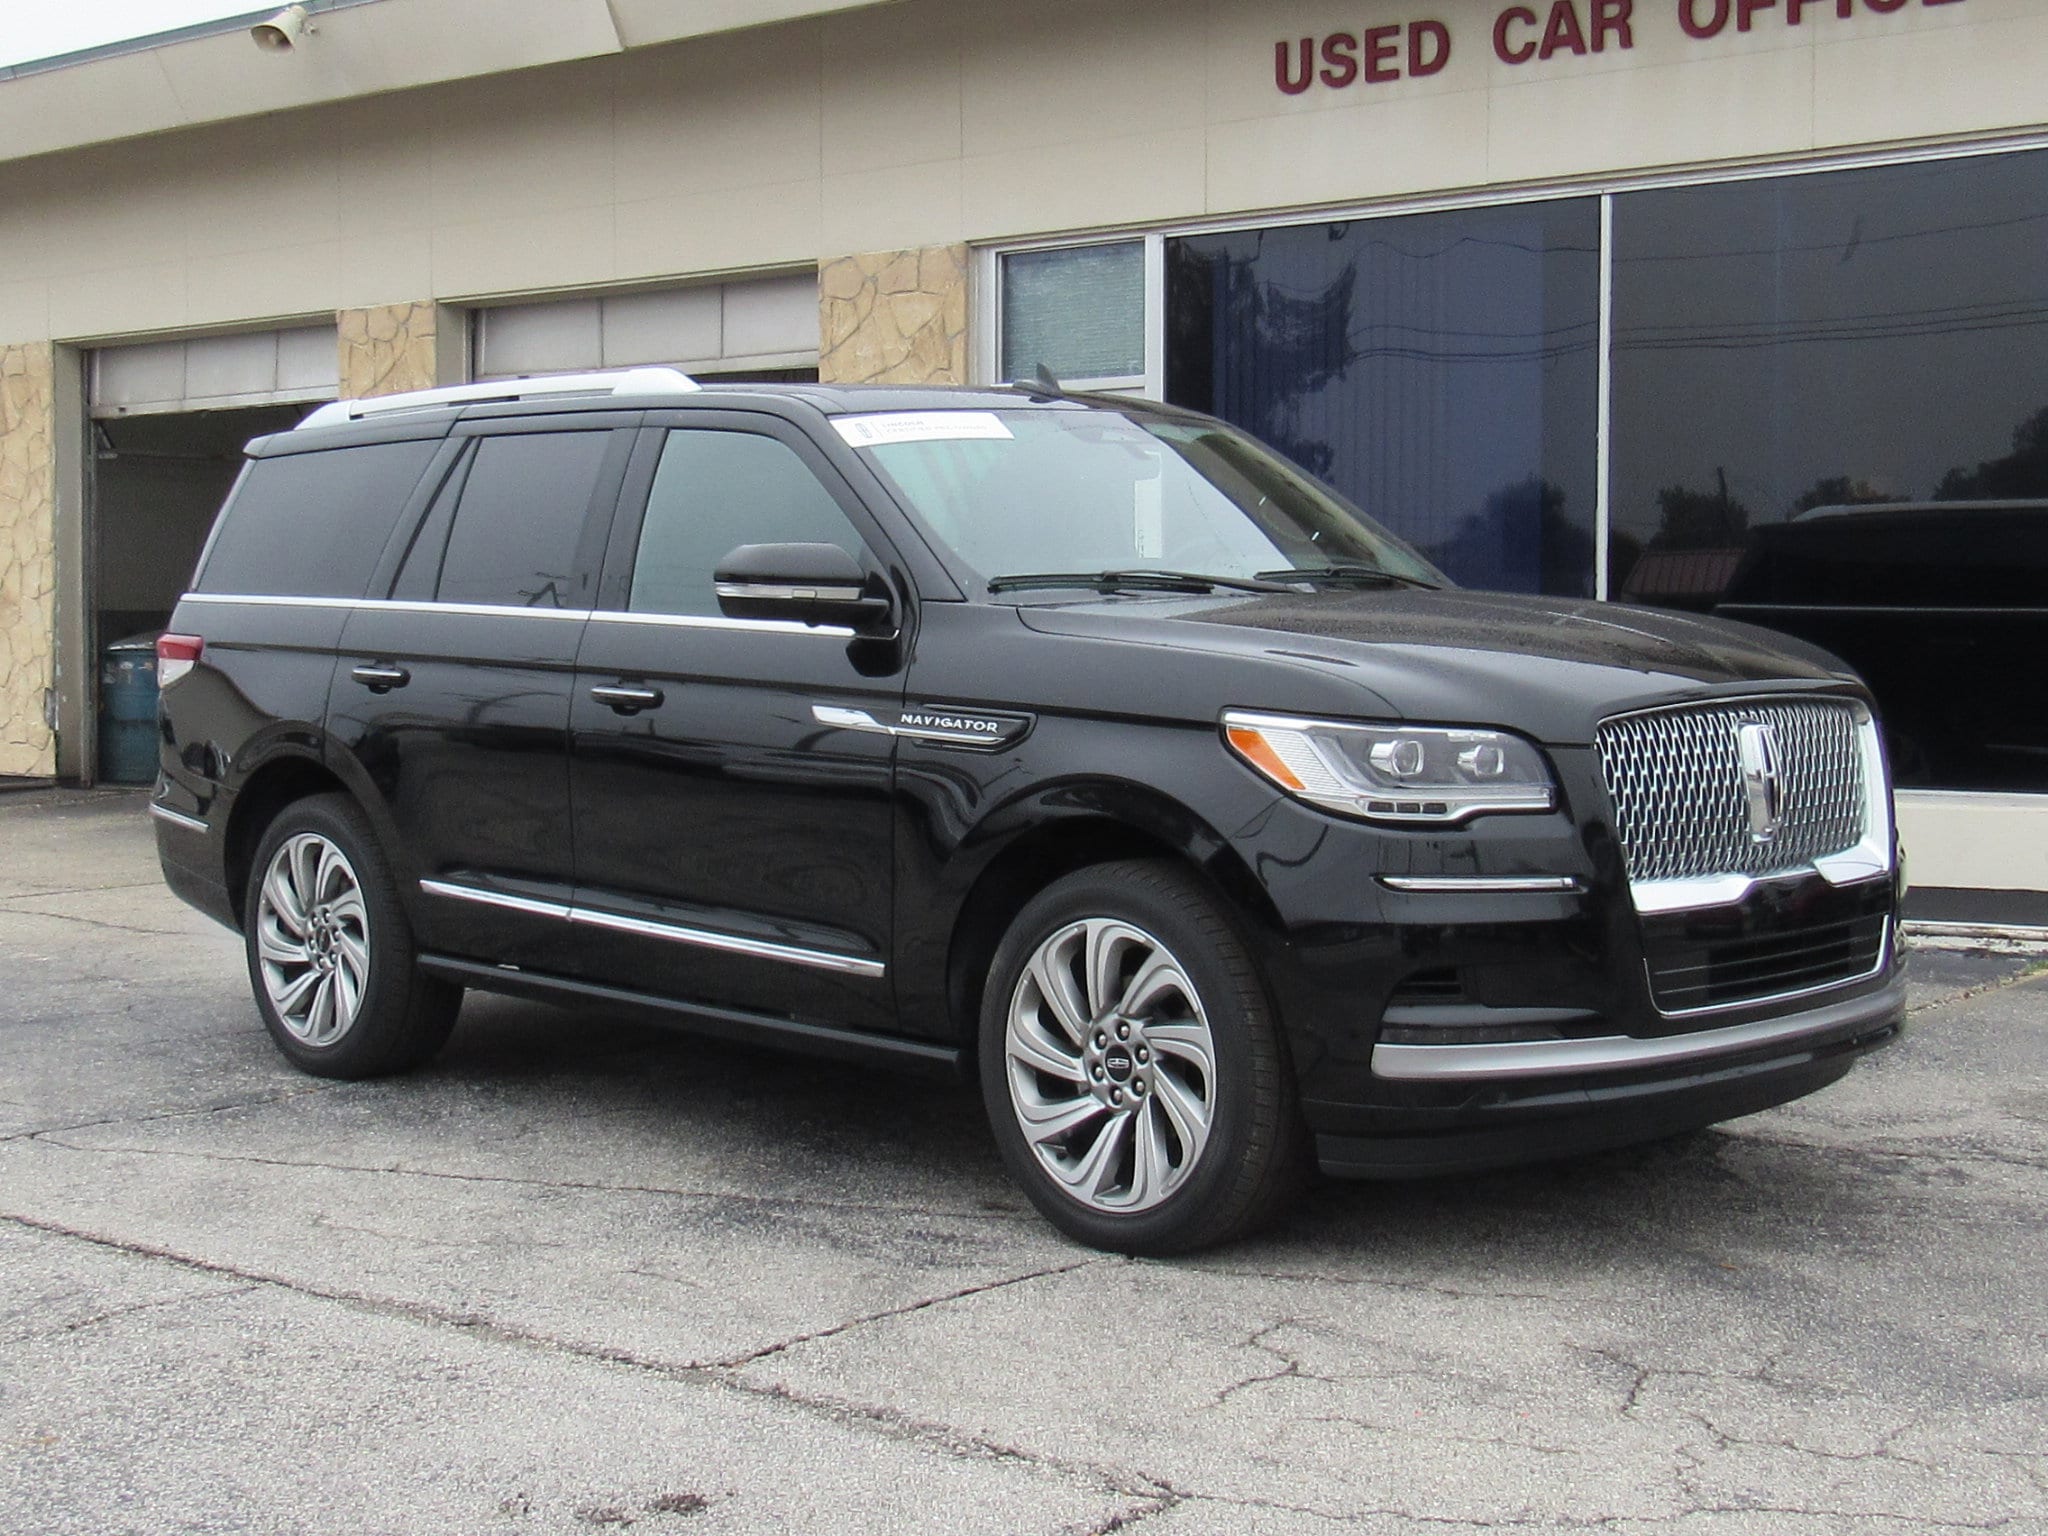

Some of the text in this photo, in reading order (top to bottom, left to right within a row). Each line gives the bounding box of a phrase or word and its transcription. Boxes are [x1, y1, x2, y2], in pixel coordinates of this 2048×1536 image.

[1275, 19, 1451, 96] USED
[1493, 0, 1633, 65] CAR
[900, 713, 999, 733] NAVIGATOR
